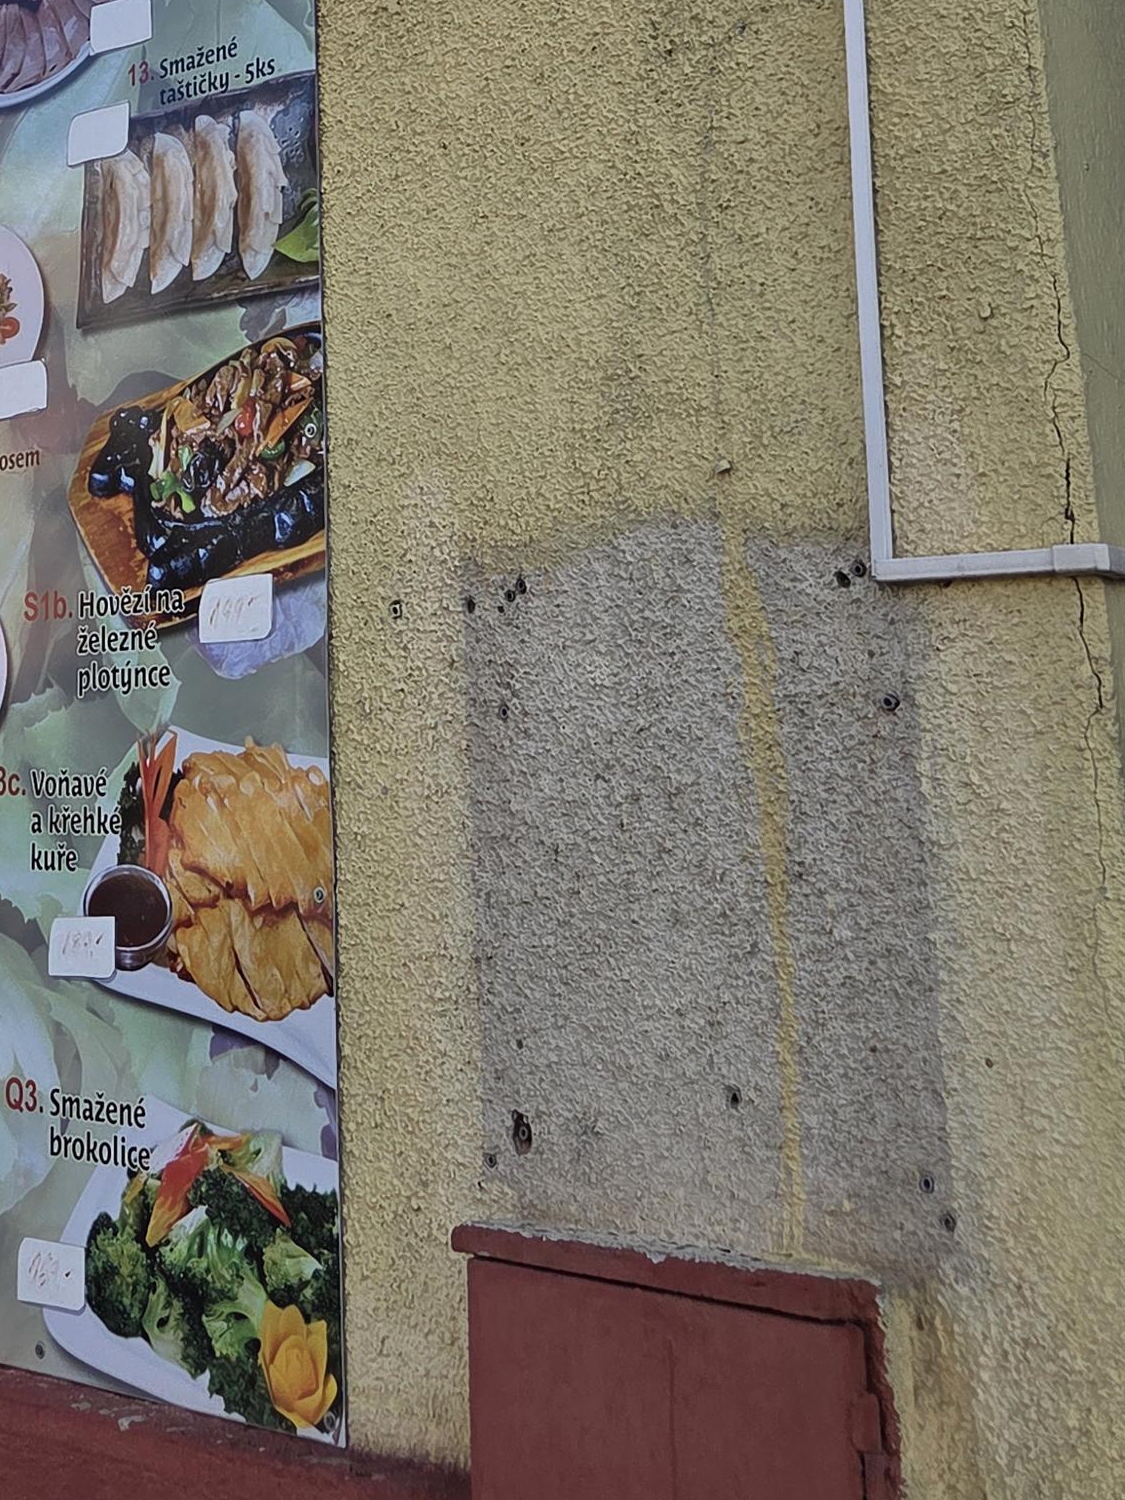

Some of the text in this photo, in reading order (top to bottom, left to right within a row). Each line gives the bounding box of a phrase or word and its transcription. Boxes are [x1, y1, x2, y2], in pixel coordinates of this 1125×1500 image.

[128, 35, 238, 87] 13. Smažené
[159, 71, 230, 106] taštičky
[245, 57, 276, 84] 5ks
[23, 585, 184, 621] S1b. Hovězí na
[77, 622, 156, 653] železné
[78, 661, 170, 697] plotýnce
[31, 768, 107, 797] Voňavé
[31, 806, 121, 835] a křehké
[31, 842, 77, 871] kuře
[5, 1077, 146, 1128] Q3. Smažené
[50, 1126, 150, 1170] brokolice
